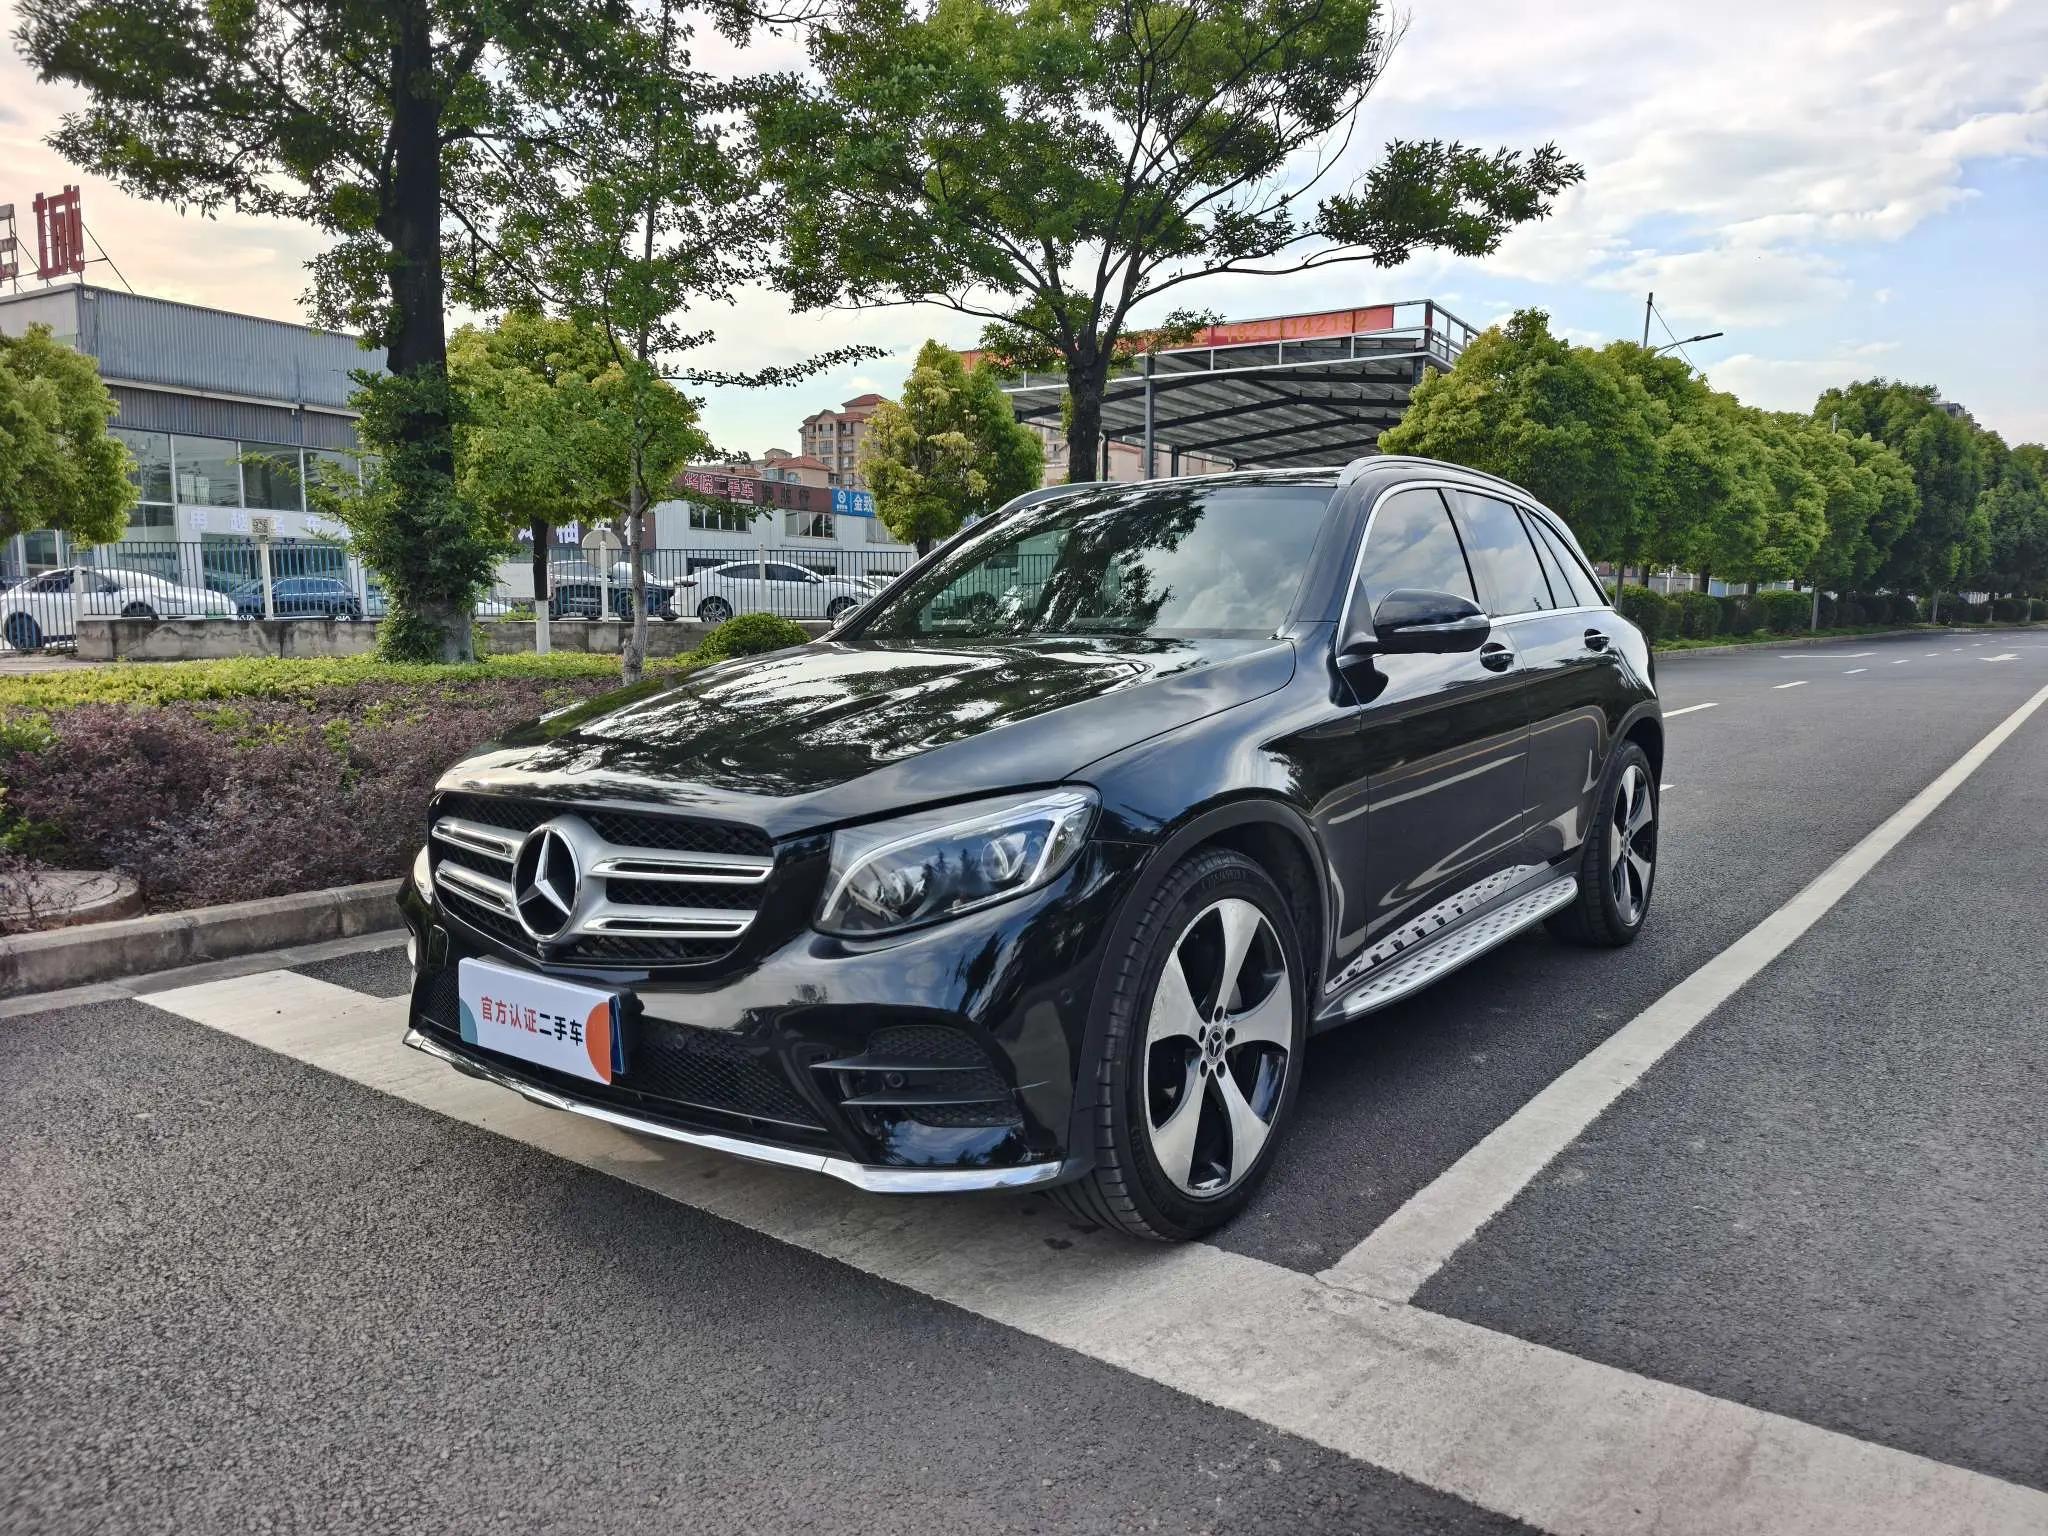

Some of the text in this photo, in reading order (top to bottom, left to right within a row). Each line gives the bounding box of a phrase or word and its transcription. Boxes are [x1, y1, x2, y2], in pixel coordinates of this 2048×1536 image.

[0, 185, 85, 281] 城
[481, 996, 583, 1047] 官方认证二手车
